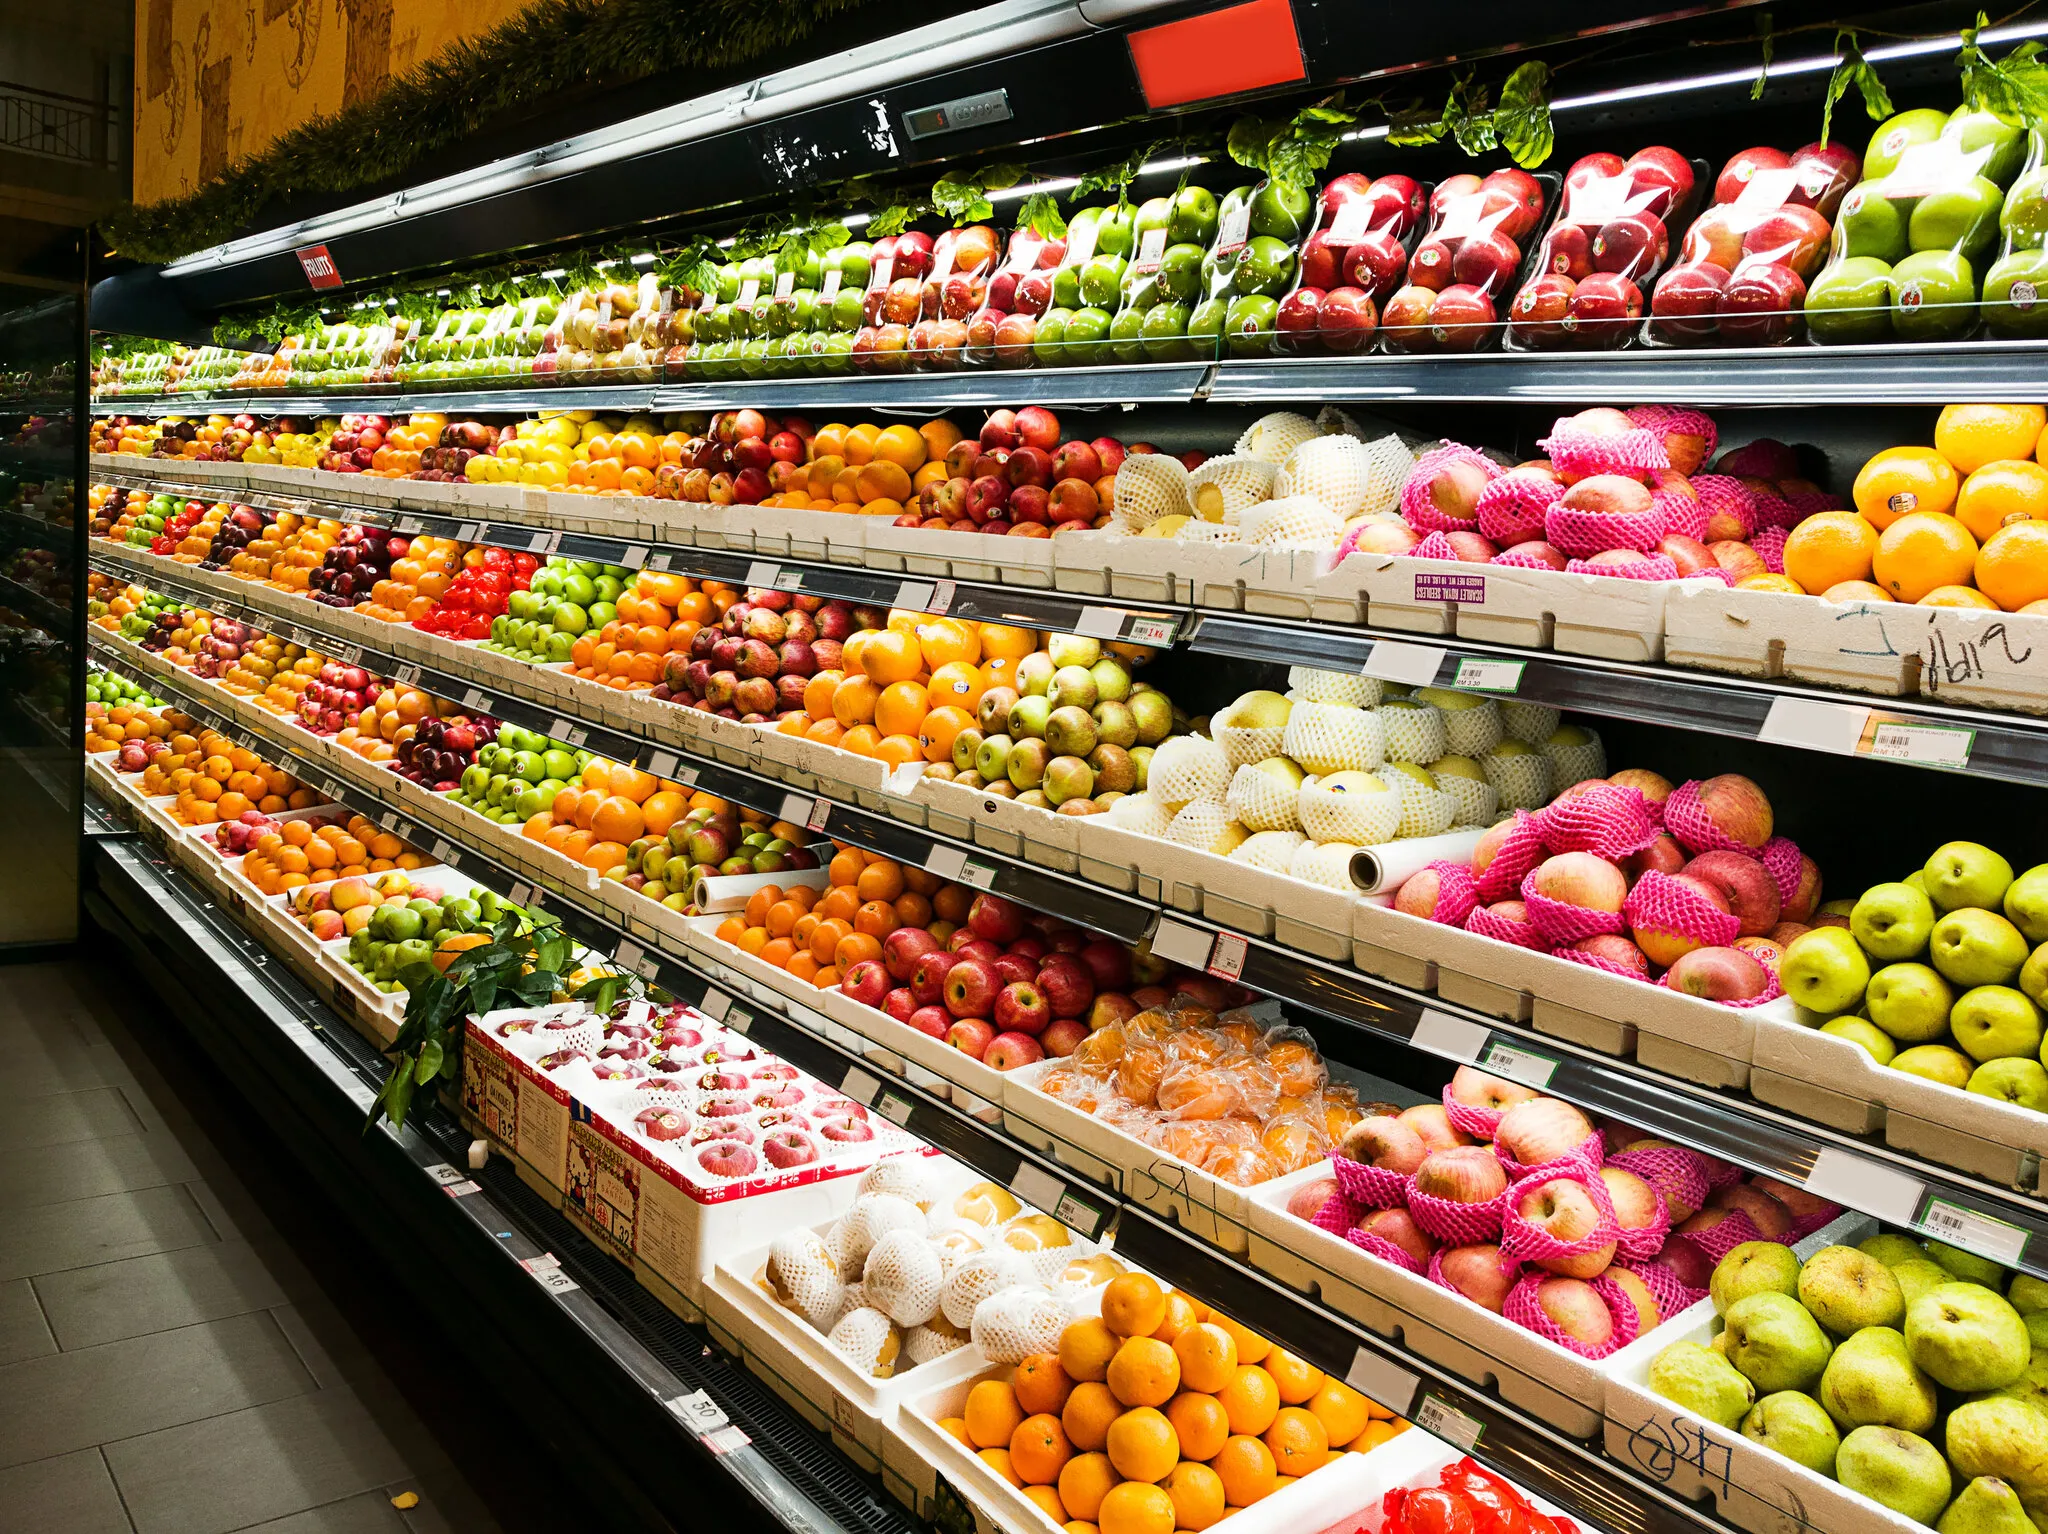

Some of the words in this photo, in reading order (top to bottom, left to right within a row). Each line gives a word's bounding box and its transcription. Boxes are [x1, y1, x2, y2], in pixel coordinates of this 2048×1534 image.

[302, 255, 334, 278] FRUITS
[1416, 586, 1442, 600] SEEDLESS
[1442, 588, 1459, 600] ROYAL
[1891, 749, 1909, 757] 1.70
[501, 1119, 513, 1140] 32
[619, 1225, 630, 1246] 32
[1923, 1223, 1940, 1234] RM
[546, 1273, 569, 1287] 46
[692, 1400, 717, 1417] 50
[1417, 1415, 1428, 1425] RM
[1428, 1421, 1441, 1432] 3.70
